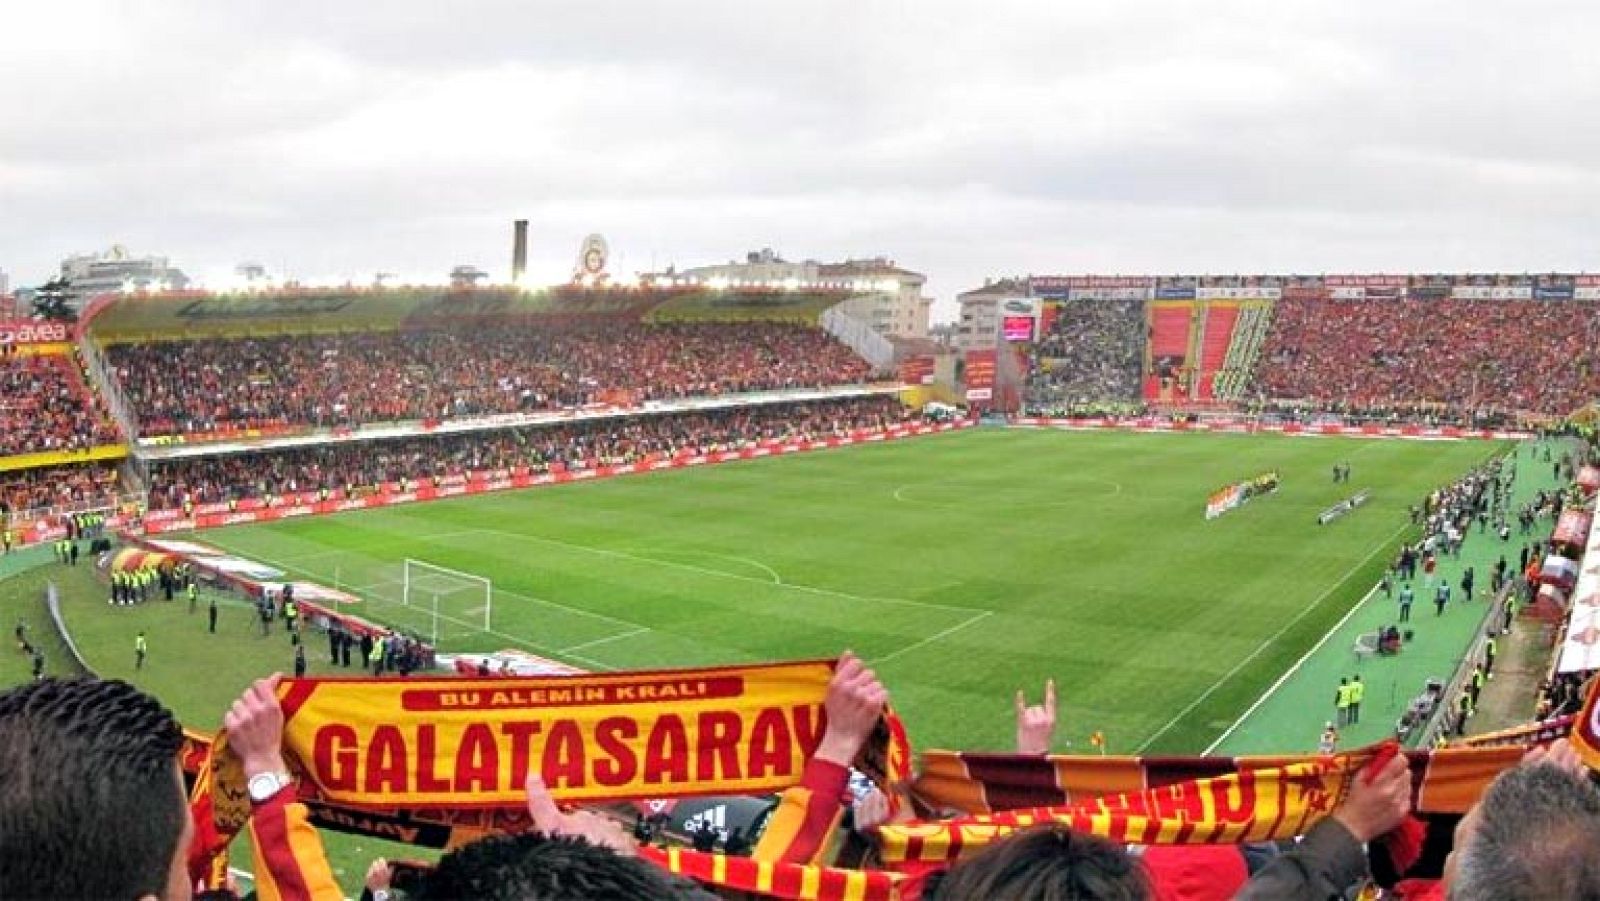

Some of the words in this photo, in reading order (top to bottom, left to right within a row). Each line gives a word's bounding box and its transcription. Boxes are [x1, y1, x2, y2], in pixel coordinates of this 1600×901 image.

[19, 324, 66, 341] avea
[440, 692, 480, 706] BU
[493, 687, 605, 704] ALEMİN
[617, 682, 706, 699] KRALI
[314, 704, 828, 793] GALATASARAY
